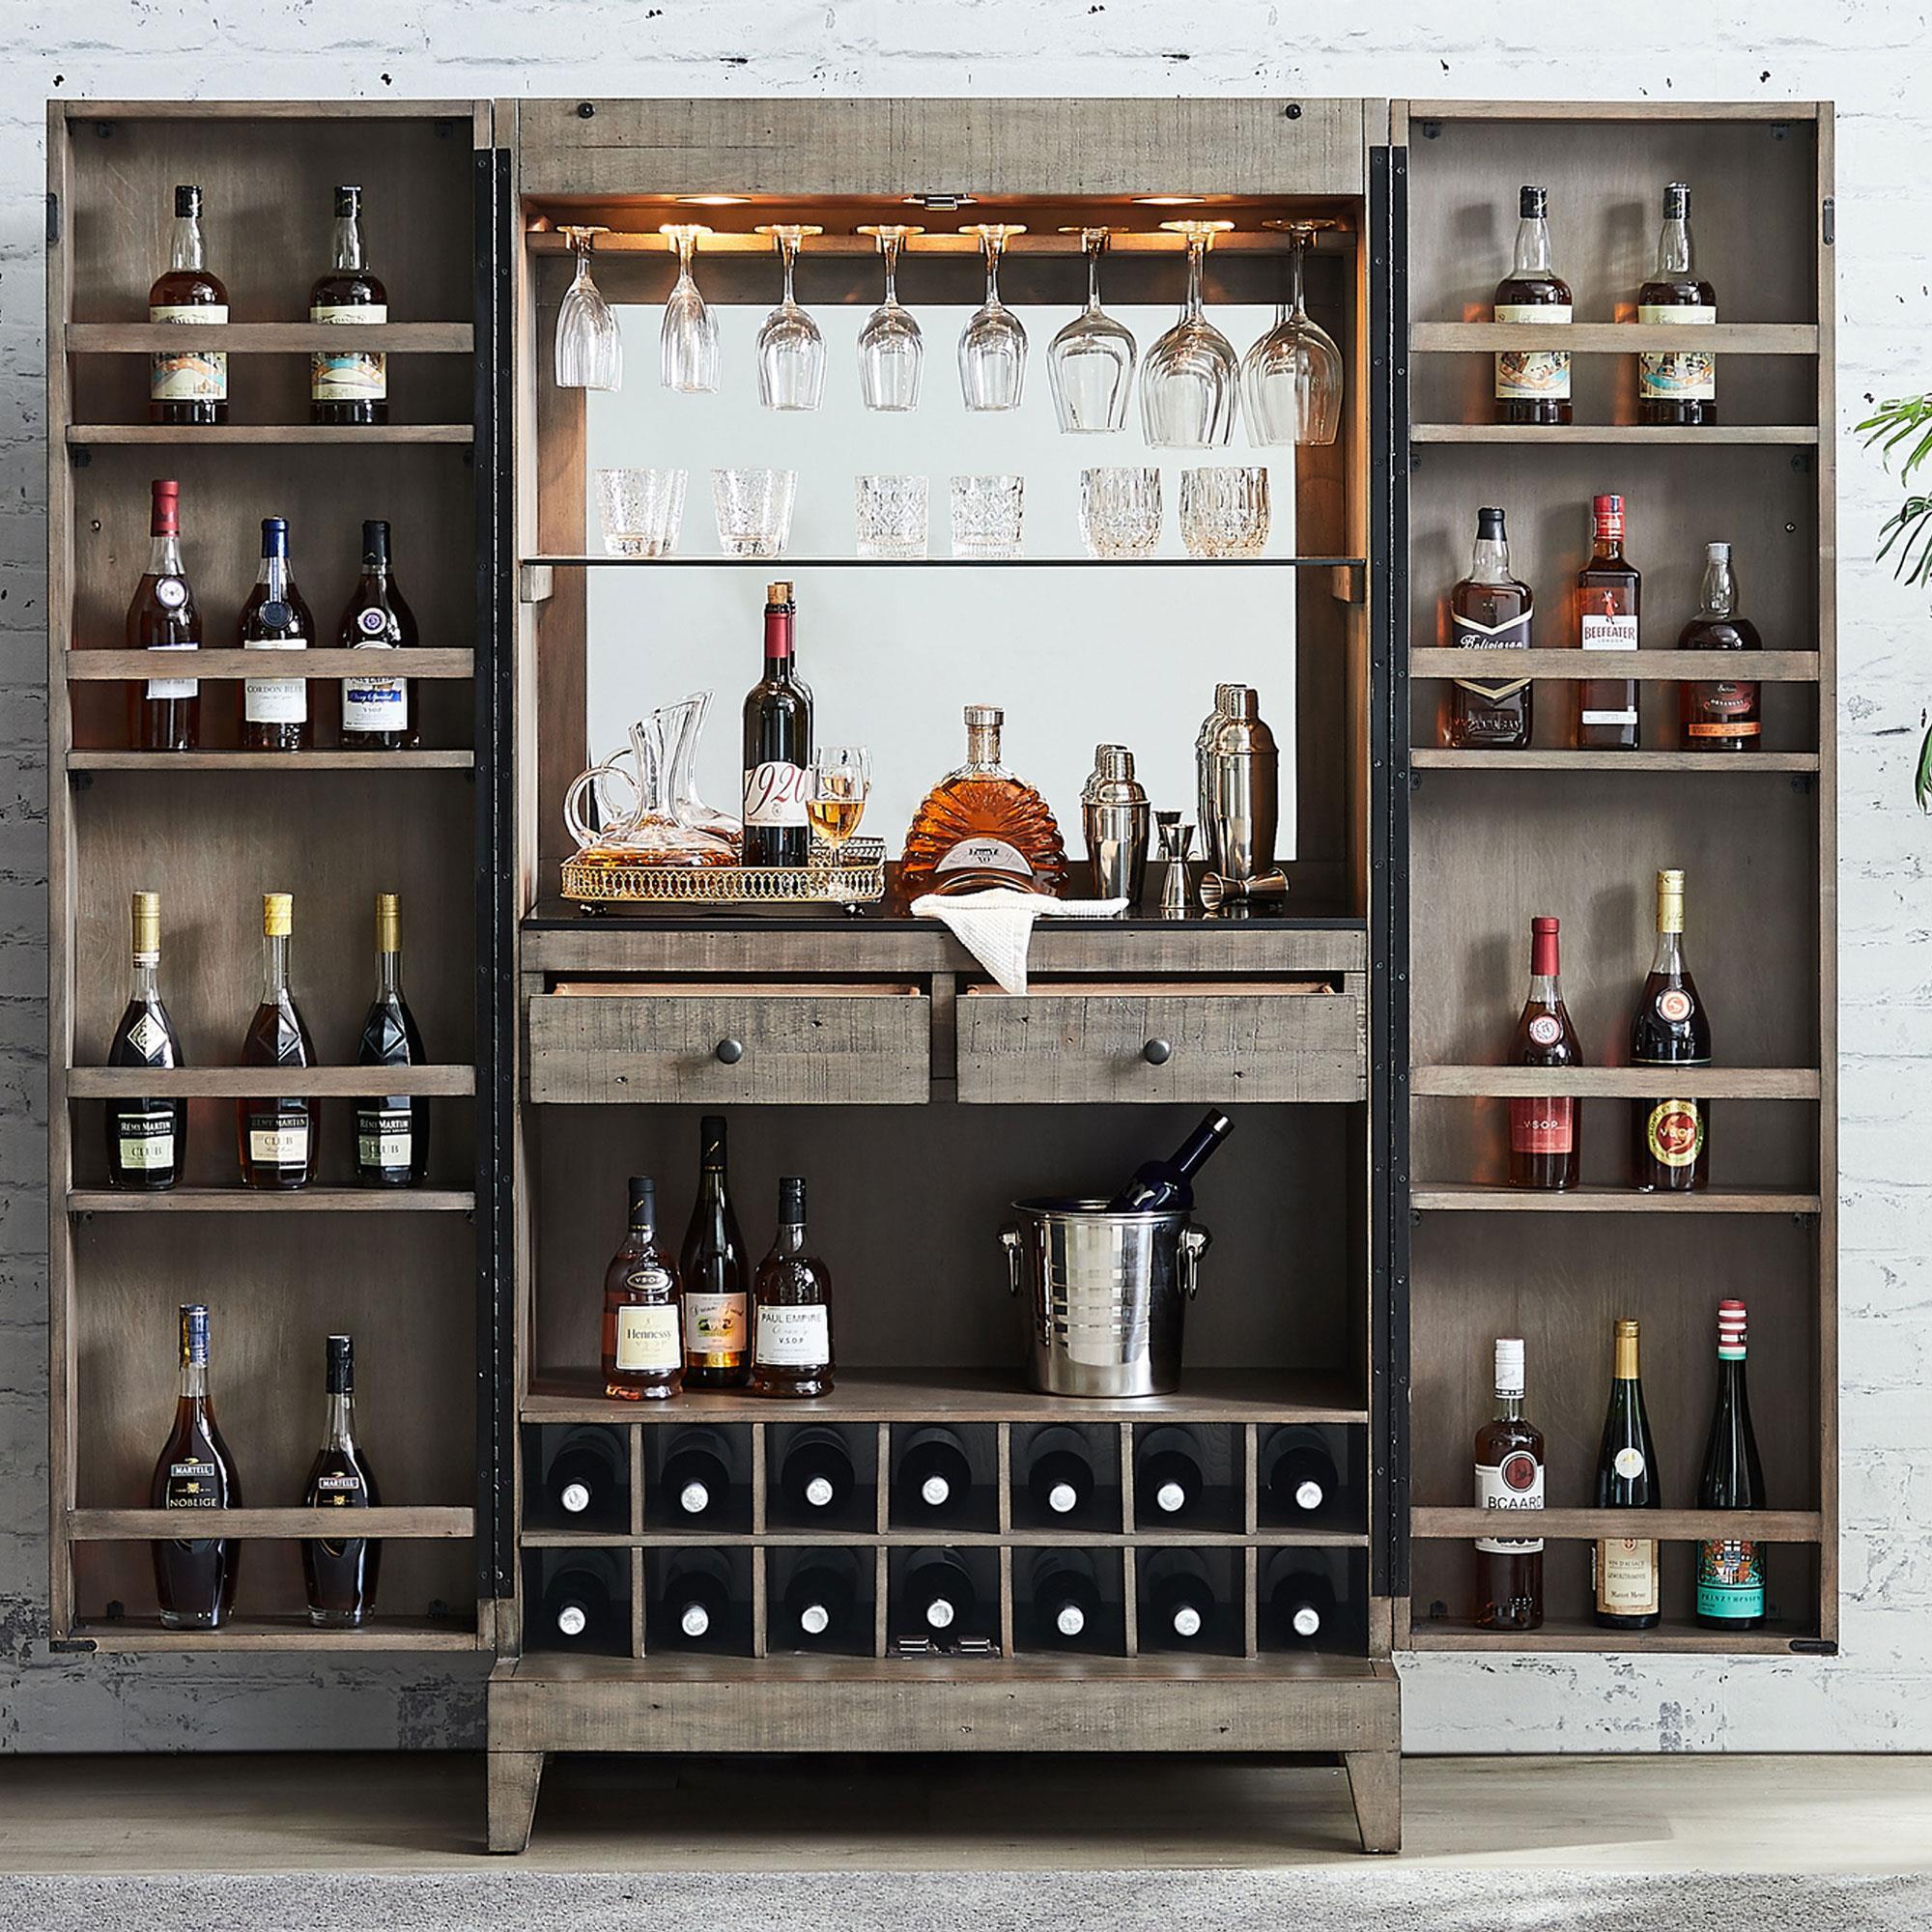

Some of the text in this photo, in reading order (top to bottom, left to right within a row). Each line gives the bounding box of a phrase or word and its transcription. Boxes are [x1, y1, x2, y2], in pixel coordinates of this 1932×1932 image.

[1584, 626, 1635, 640] BEEFEATER
[246, 685, 281, 694] CORDON
[142, 1121, 171, 1131] MARTIN
[275, 1119, 305, 1127] MARTIN
[264, 1136, 294, 1146] CLUB
[130, 1147, 162, 1157] CLUB
[761, 1313, 823, 1323] PAUL EMPIRE
[627, 1328, 671, 1341] Hennessy
[175, 1465, 212, 1475] MARTELL
[169, 1497, 217, 1508] NOBLIGE
